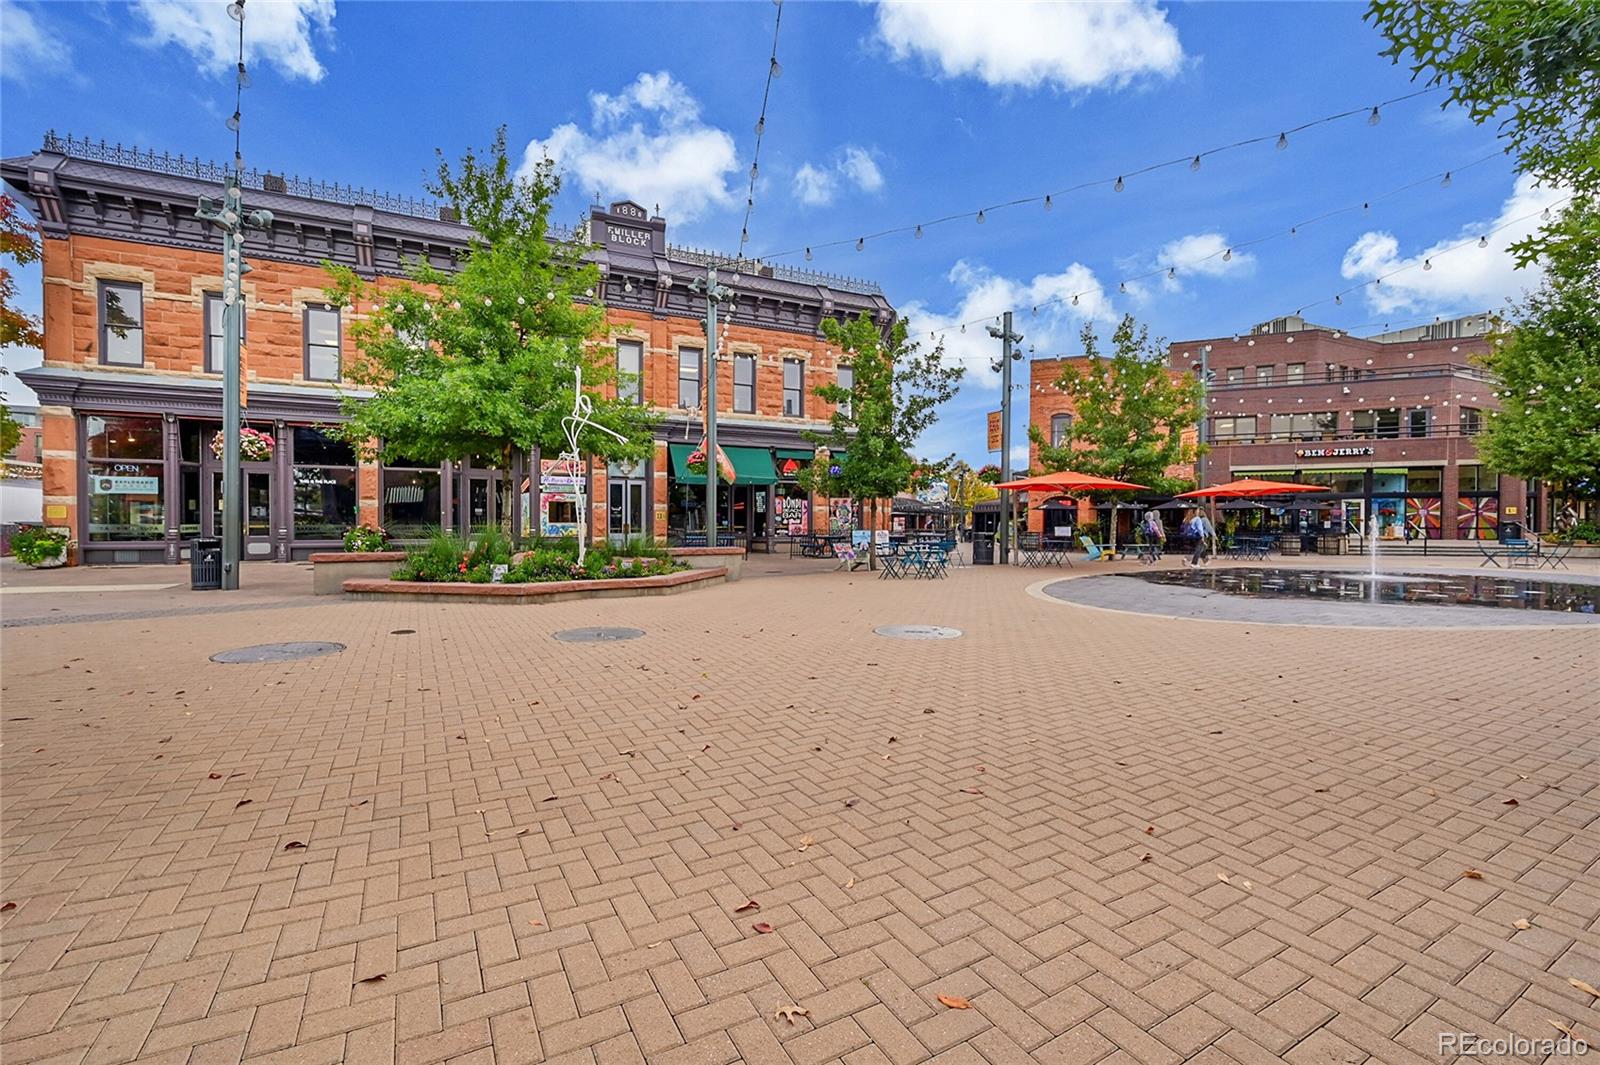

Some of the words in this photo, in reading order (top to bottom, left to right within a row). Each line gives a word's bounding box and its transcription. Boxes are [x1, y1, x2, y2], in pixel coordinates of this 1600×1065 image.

[611, 234, 647, 247] BLOCK
[1304, 448, 1325, 457] BEN
[1332, 446, 1375, 456] JERRY'S
[114, 464, 139, 472] OPEN
[782, 496, 802, 509] BONDI
